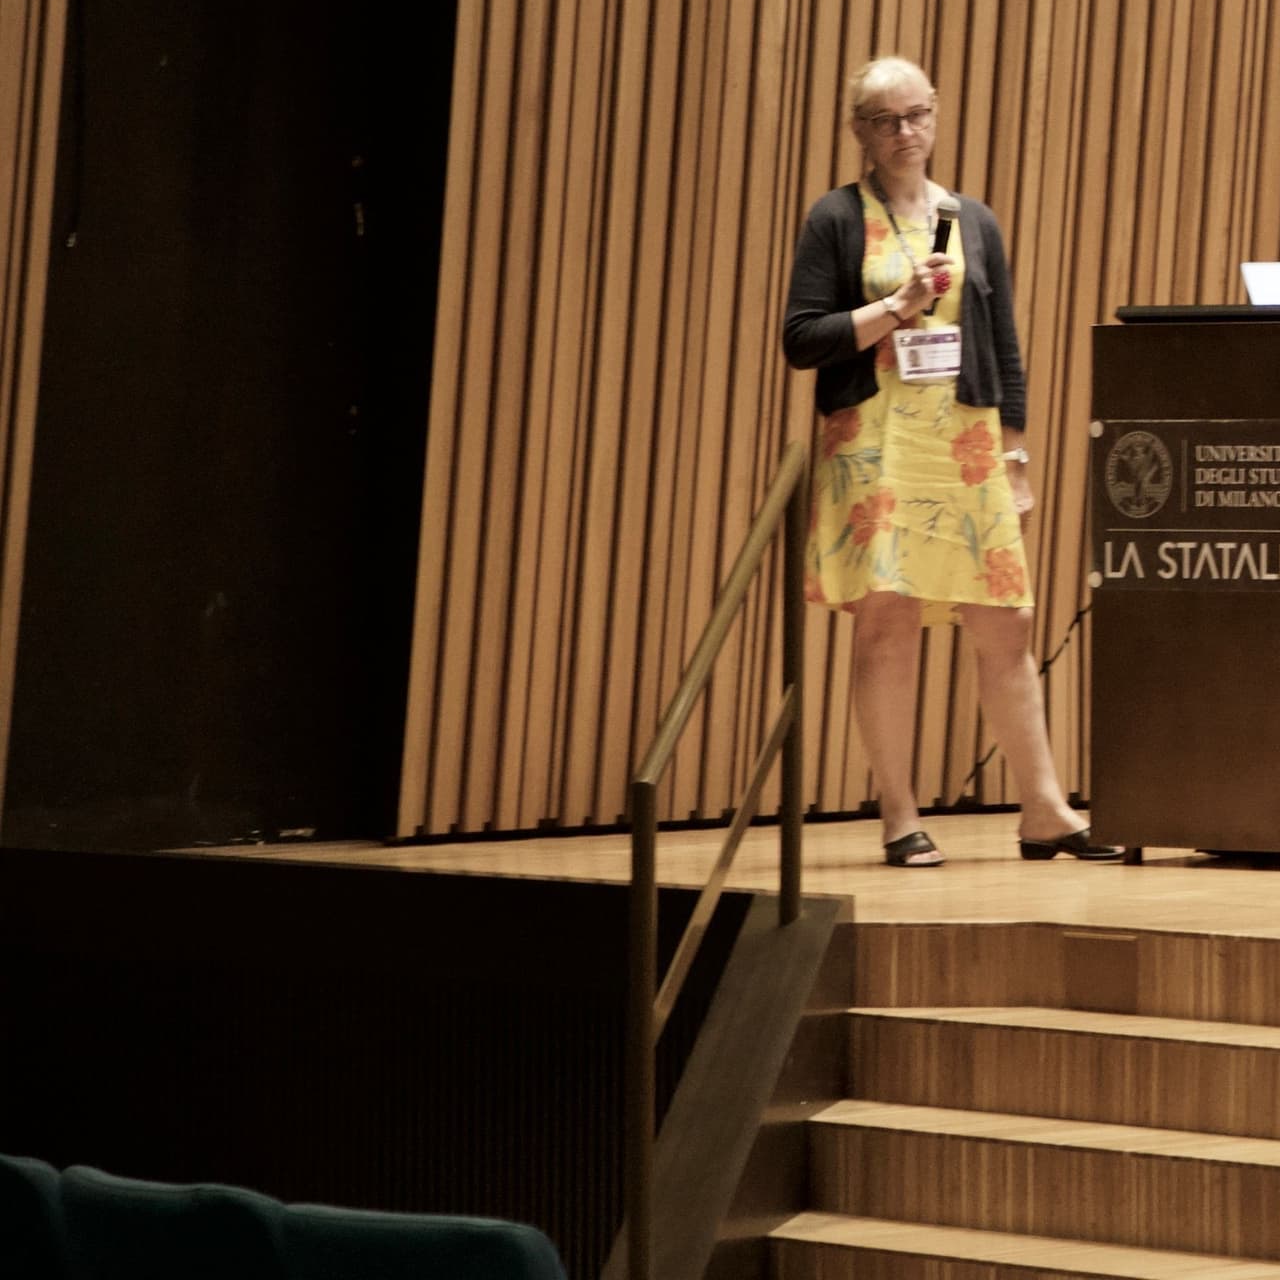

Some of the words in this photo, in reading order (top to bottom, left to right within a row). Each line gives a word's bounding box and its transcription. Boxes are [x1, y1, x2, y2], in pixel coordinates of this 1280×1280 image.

[1194, 467, 1246, 485] DEGLI
[1194, 490, 1215, 508] DI
[1104, 541, 1146, 579] LA
